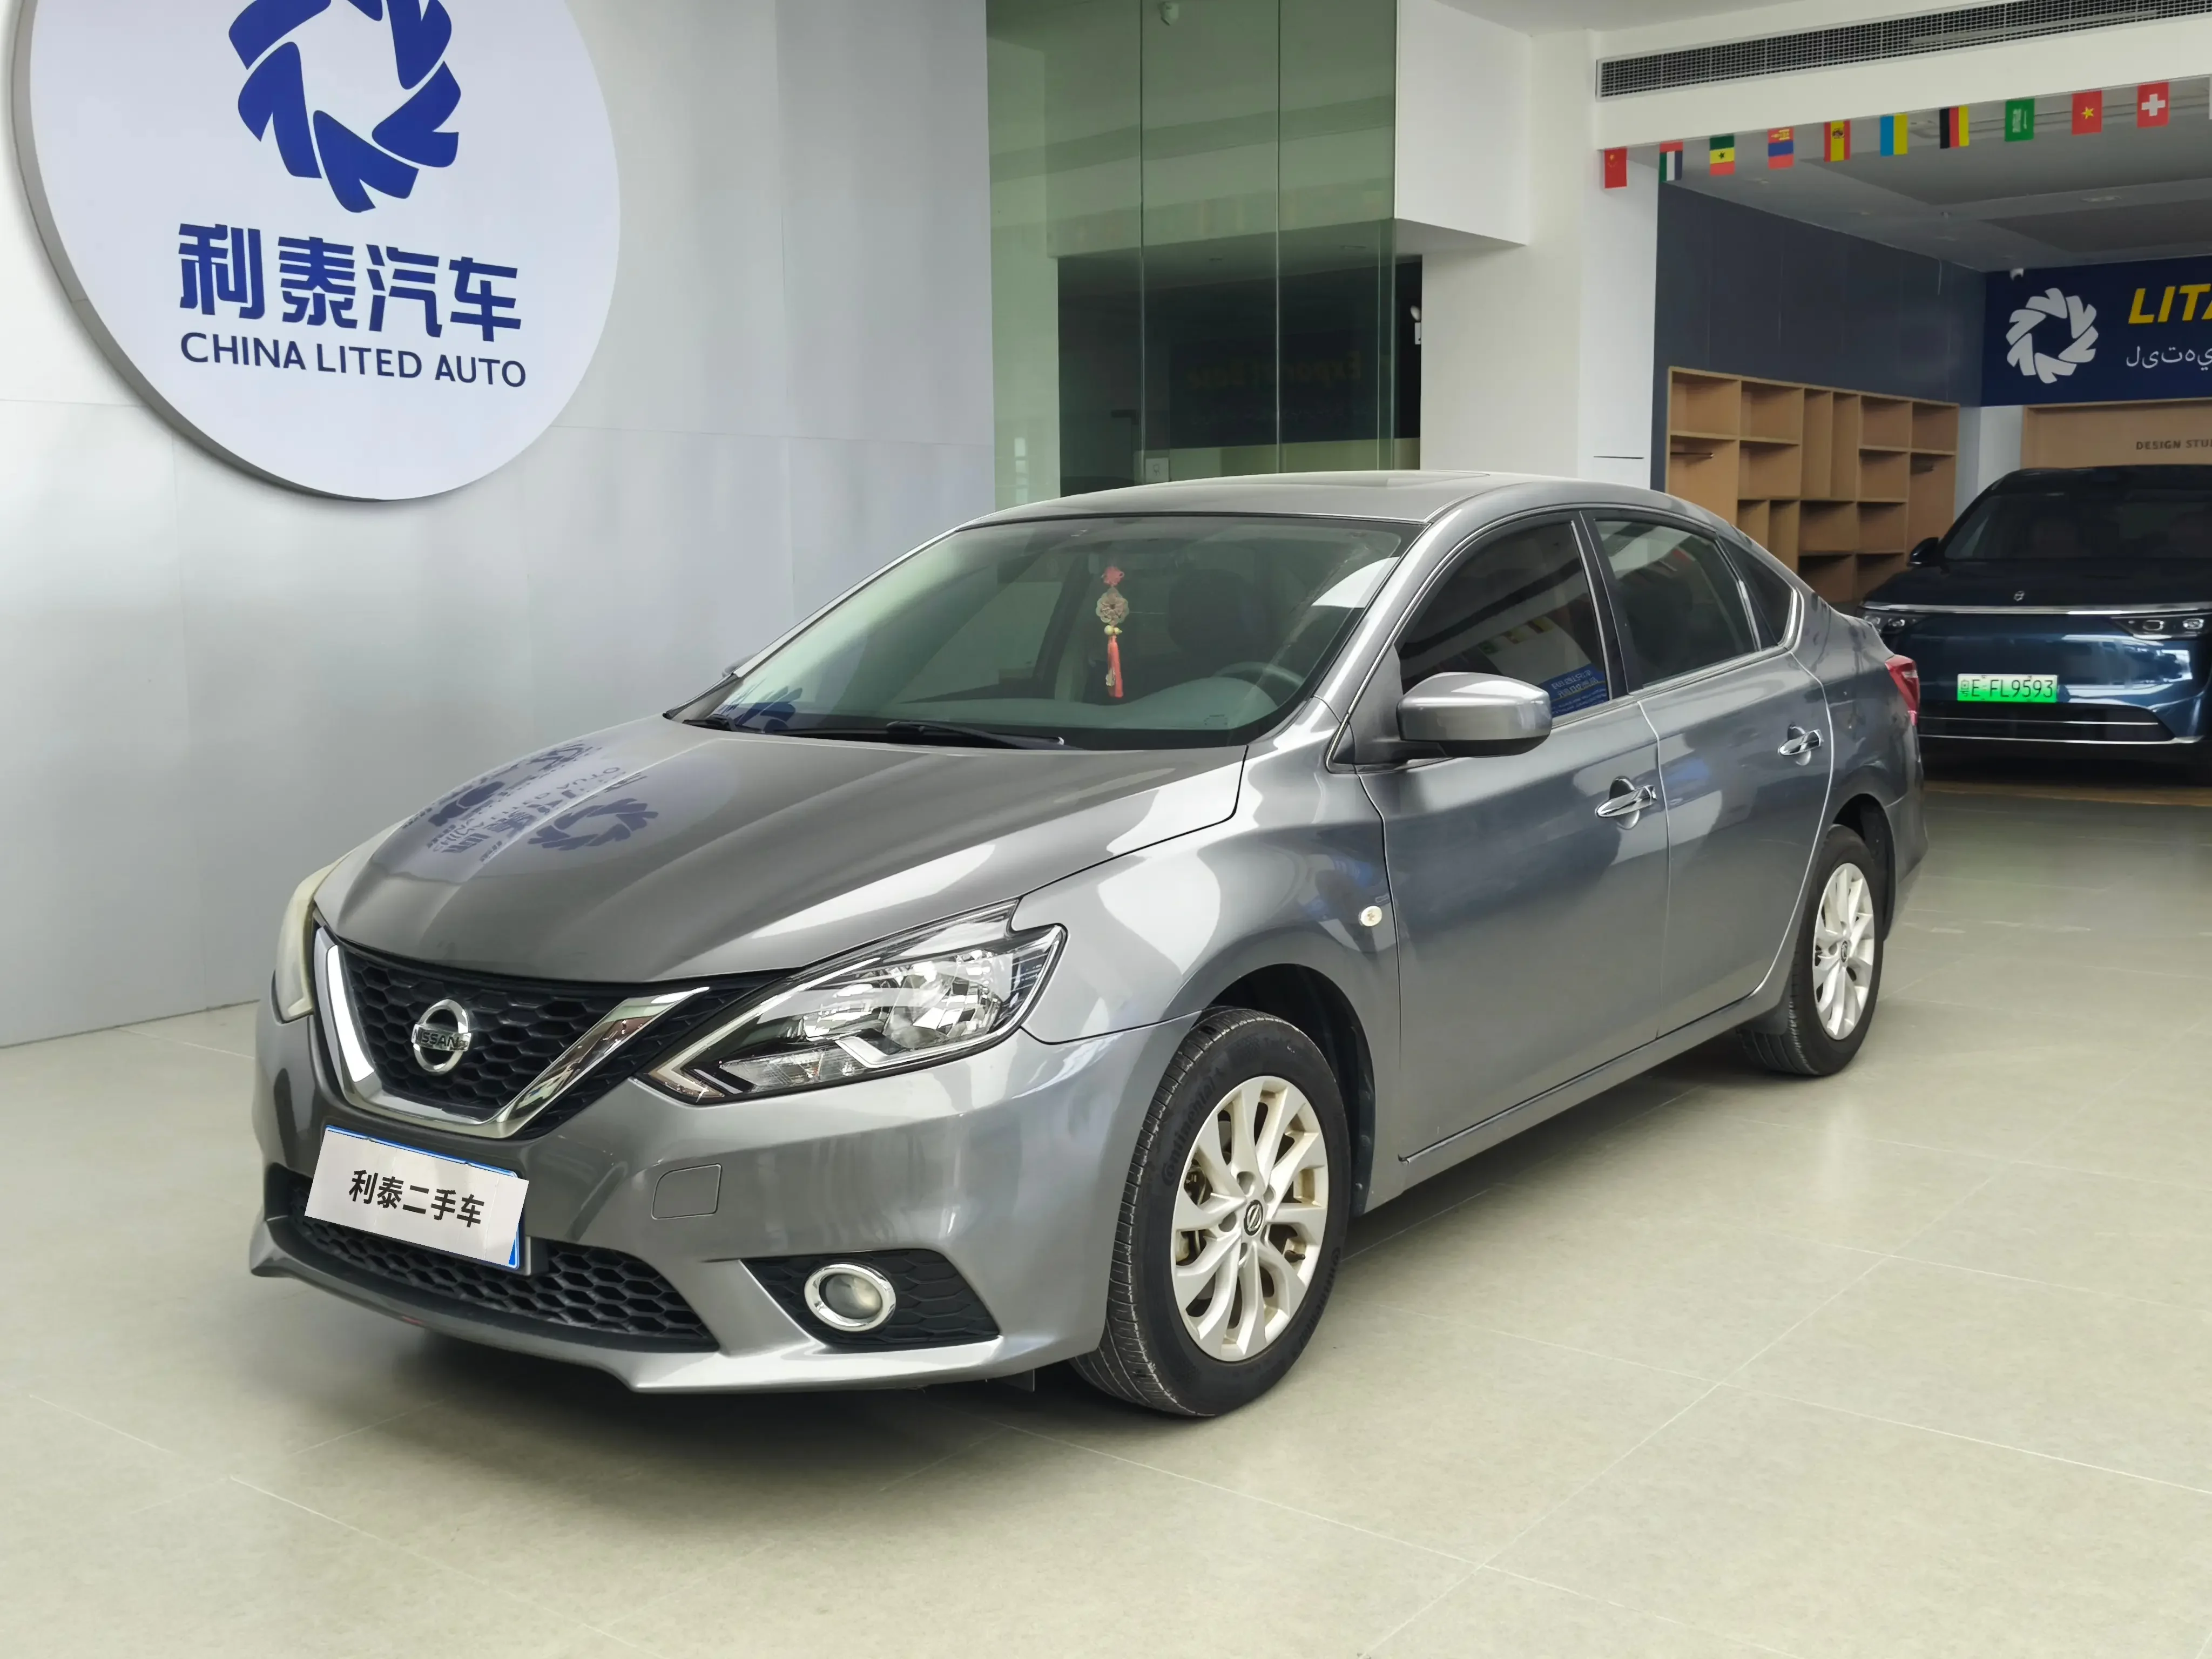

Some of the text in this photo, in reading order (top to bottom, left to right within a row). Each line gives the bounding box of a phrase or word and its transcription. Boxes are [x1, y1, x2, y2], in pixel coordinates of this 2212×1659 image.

[178, 223, 522, 342] 利泰汽车
[181, 332, 526, 388] CHINA LITED AUTO
[2136, 439, 2212, 450] DESIGN STU
[348, 1168, 485, 1228] 利泰二手车
